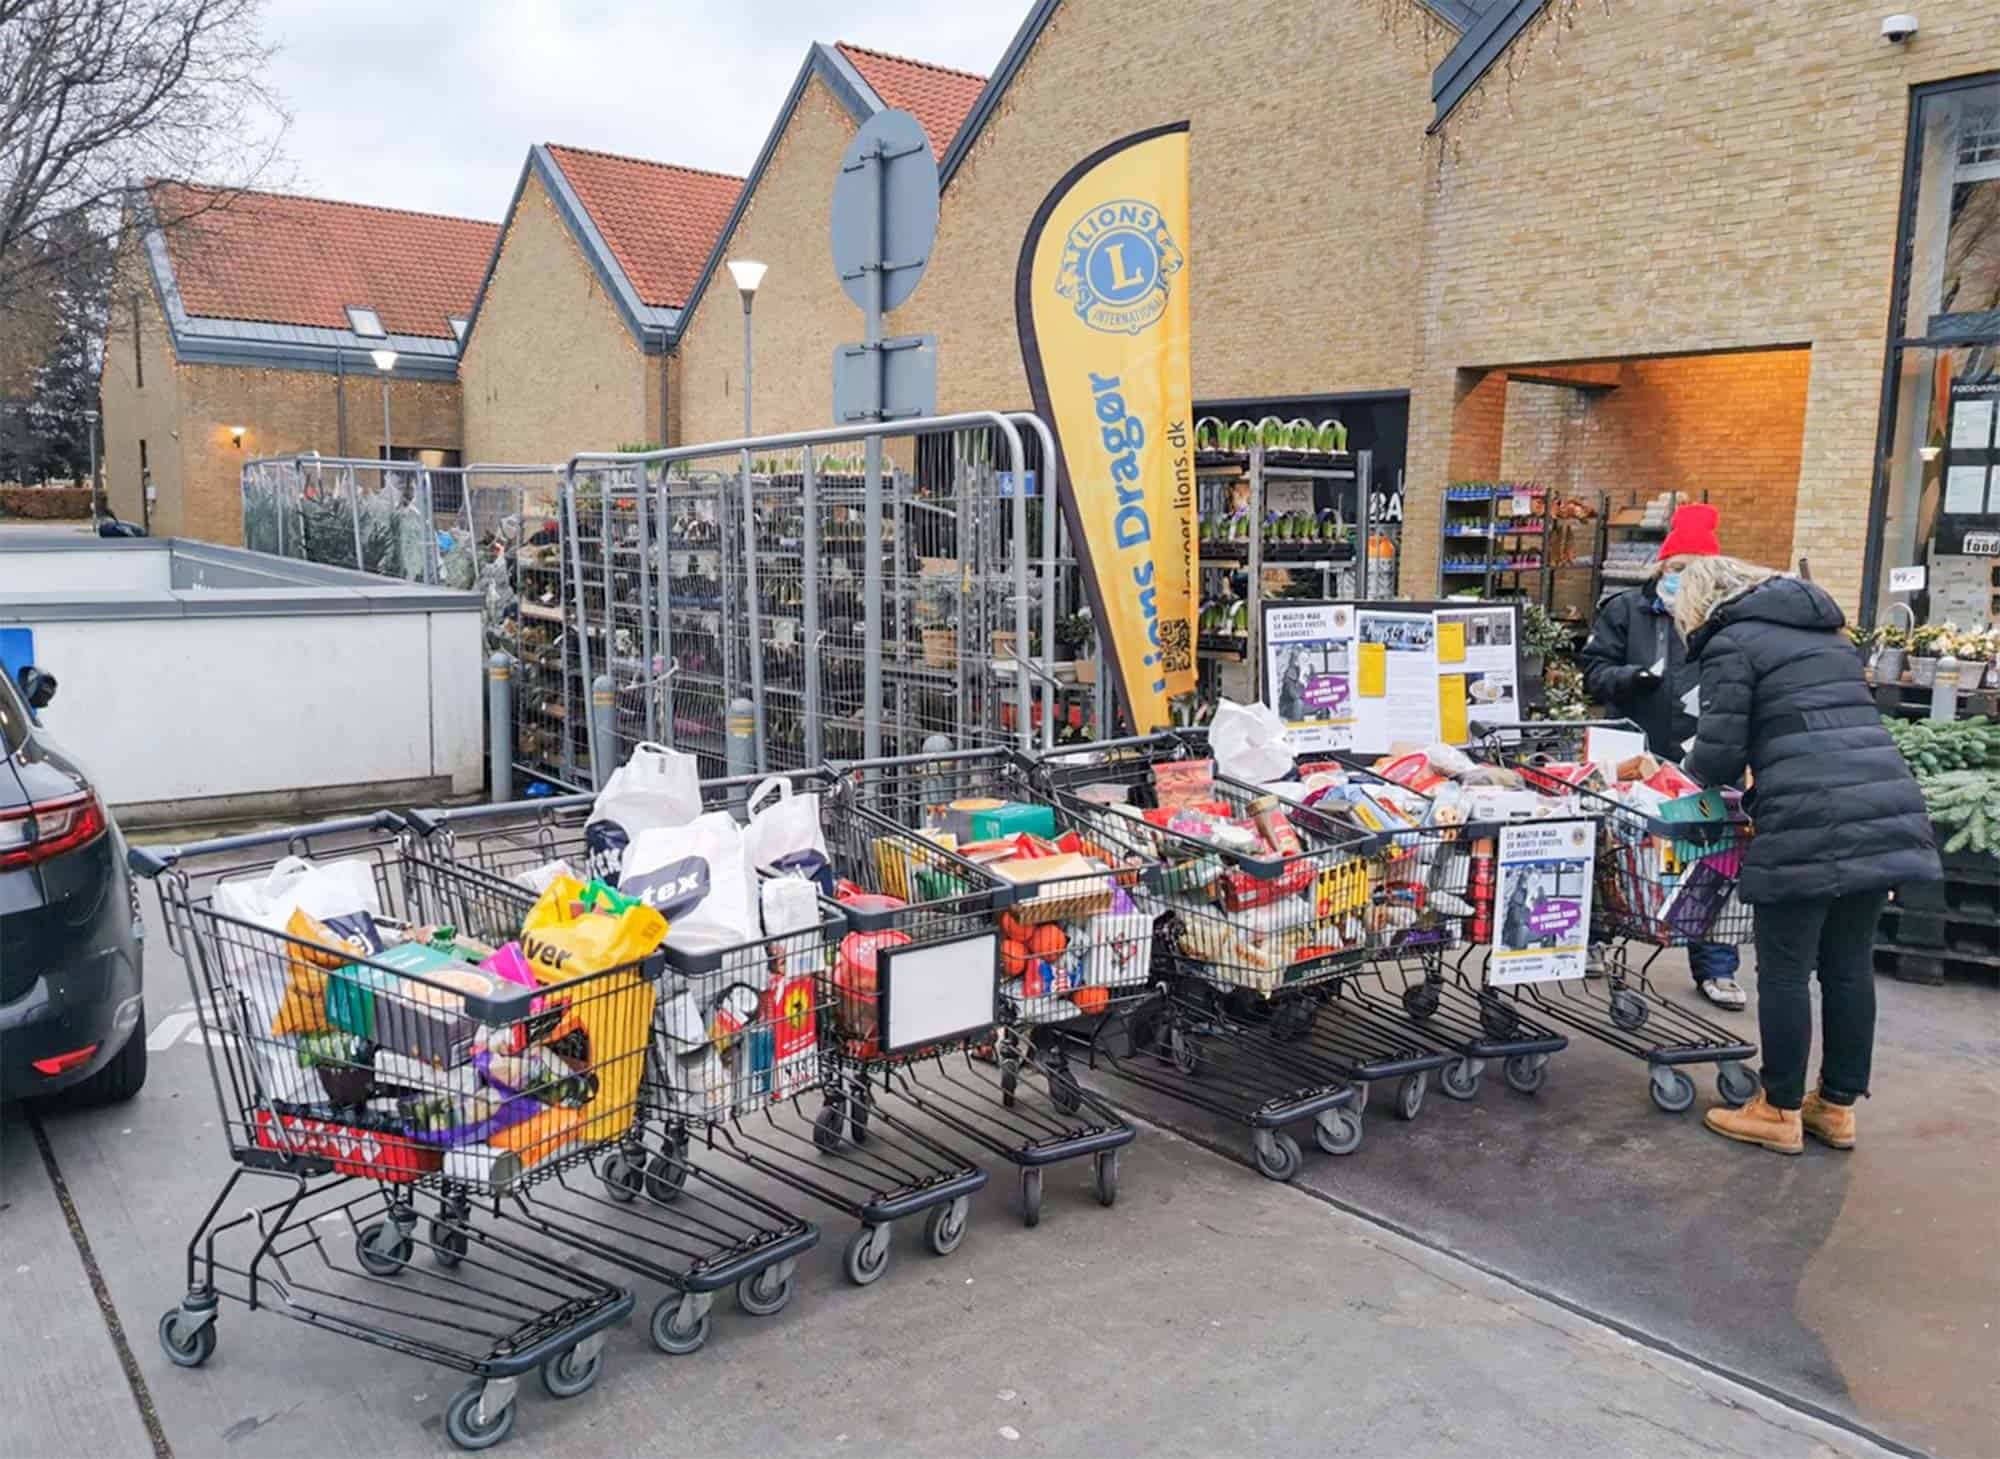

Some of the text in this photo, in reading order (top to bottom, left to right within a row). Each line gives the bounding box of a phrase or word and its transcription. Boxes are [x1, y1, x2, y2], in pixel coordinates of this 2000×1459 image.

[1076, 205, 1153, 244] LIONS
[1105, 242, 1144, 291] L
[1088, 372, 1151, 549] Dragør
